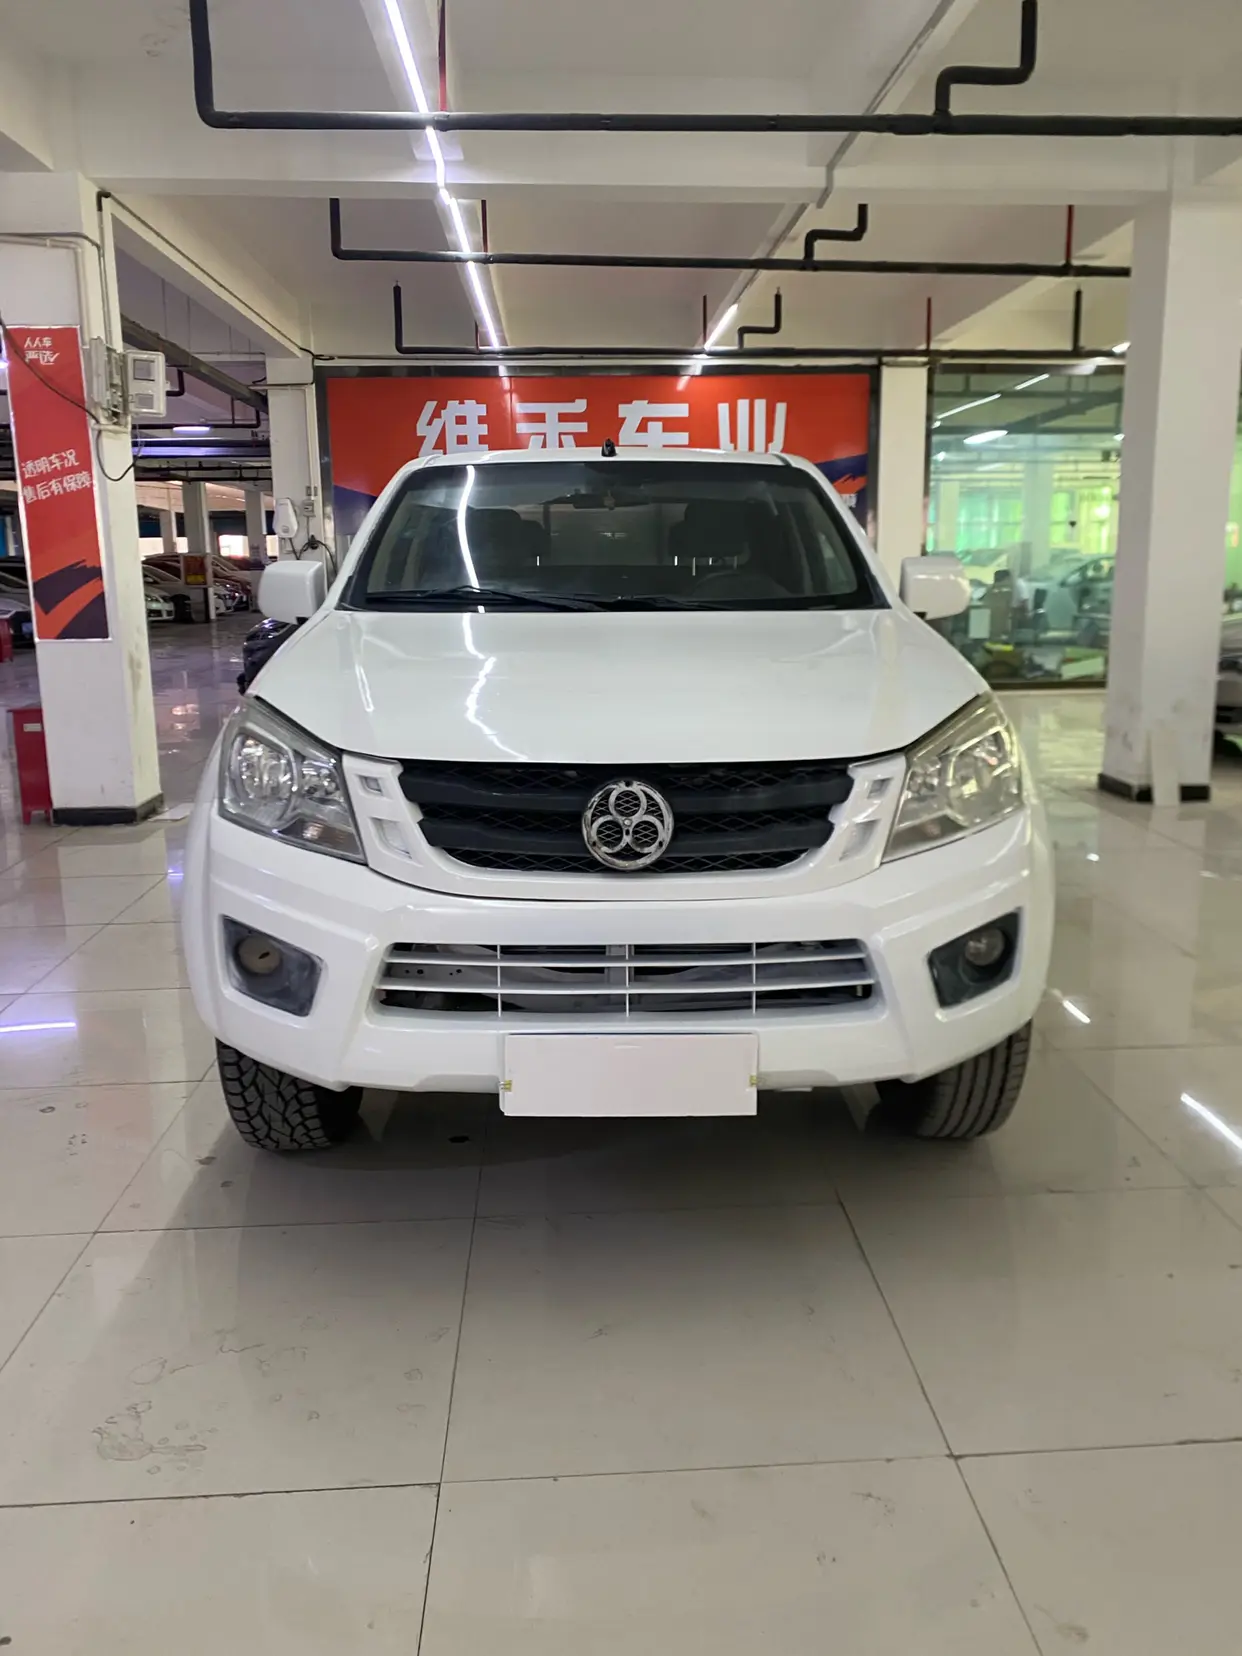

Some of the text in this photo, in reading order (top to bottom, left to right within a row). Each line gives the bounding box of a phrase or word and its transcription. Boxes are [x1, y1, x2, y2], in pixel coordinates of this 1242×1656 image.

[24, 336, 52, 348] 人人车
[416, 398, 787, 453] 维禾车业
[21, 448, 79, 479] 透明车况
[23, 471, 92, 504] 售后有保障
